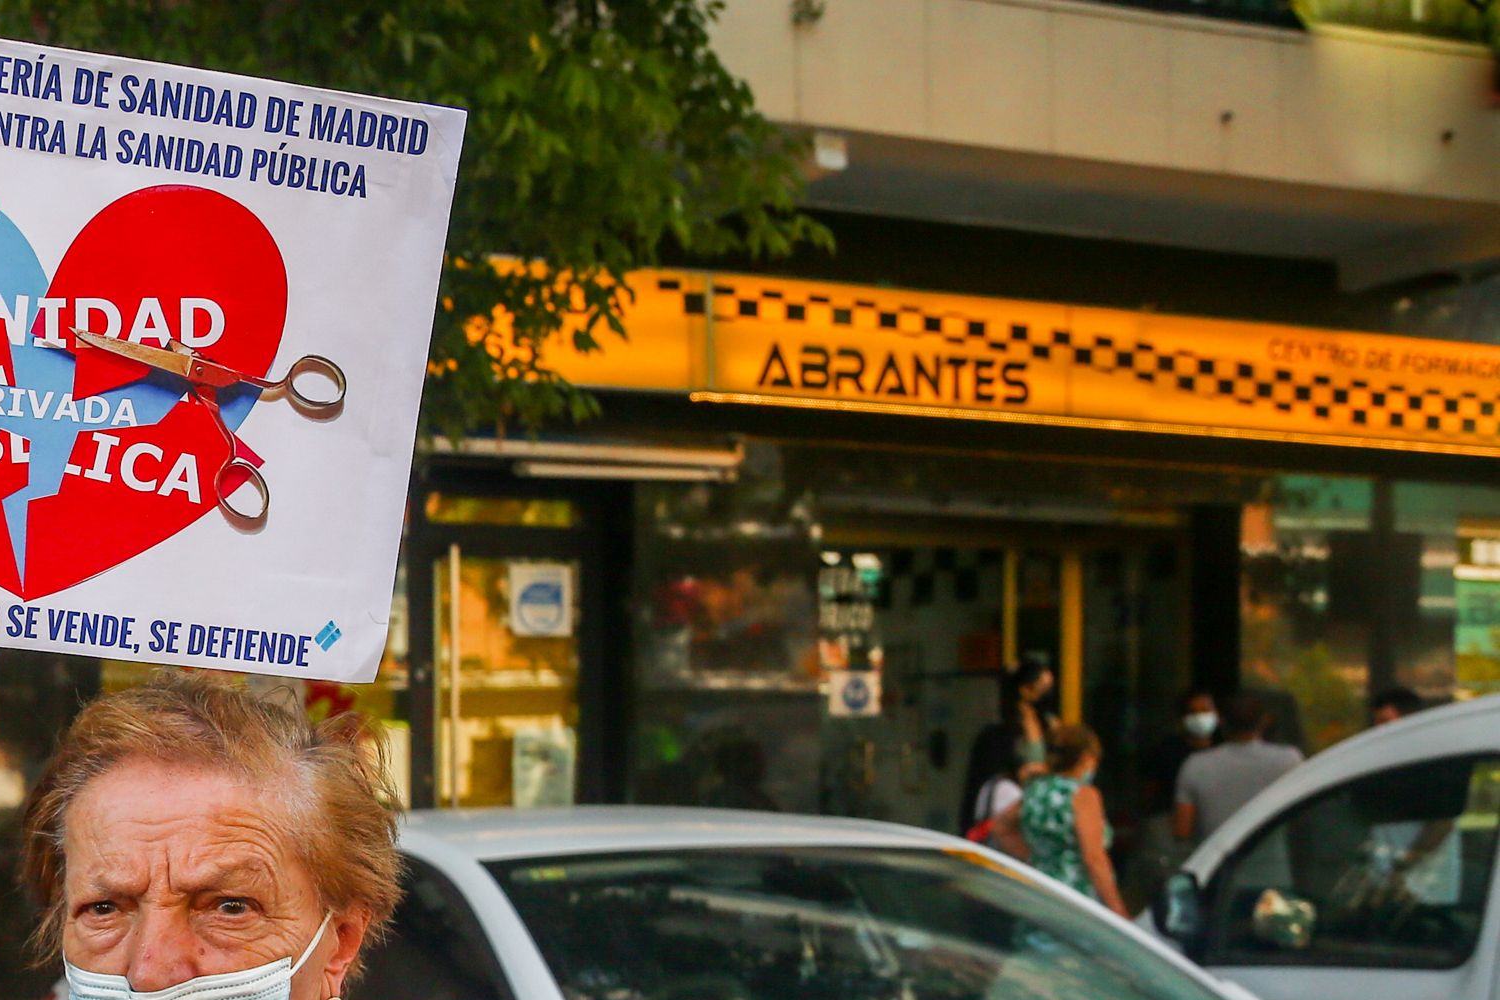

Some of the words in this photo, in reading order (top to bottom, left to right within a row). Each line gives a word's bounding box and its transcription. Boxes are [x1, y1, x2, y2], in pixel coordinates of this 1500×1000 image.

[72, 67, 113, 110] DE
[118, 74, 258, 130] SANIDAD
[264, 96, 304, 138] DE
[308, 103, 430, 156] MADRID
[75, 123, 108, 161] LA
[115, 129, 244, 179] SANIDAD
[249, 143, 367, 199] PÚBLICA
[757, 342, 1029, 405] ABRANTES
[6, 605, 41, 640] SE
[47, 608, 141, 654] VENDE,
[148, 619, 180, 654] SE
[186, 623, 312, 667] DEFIENDE
